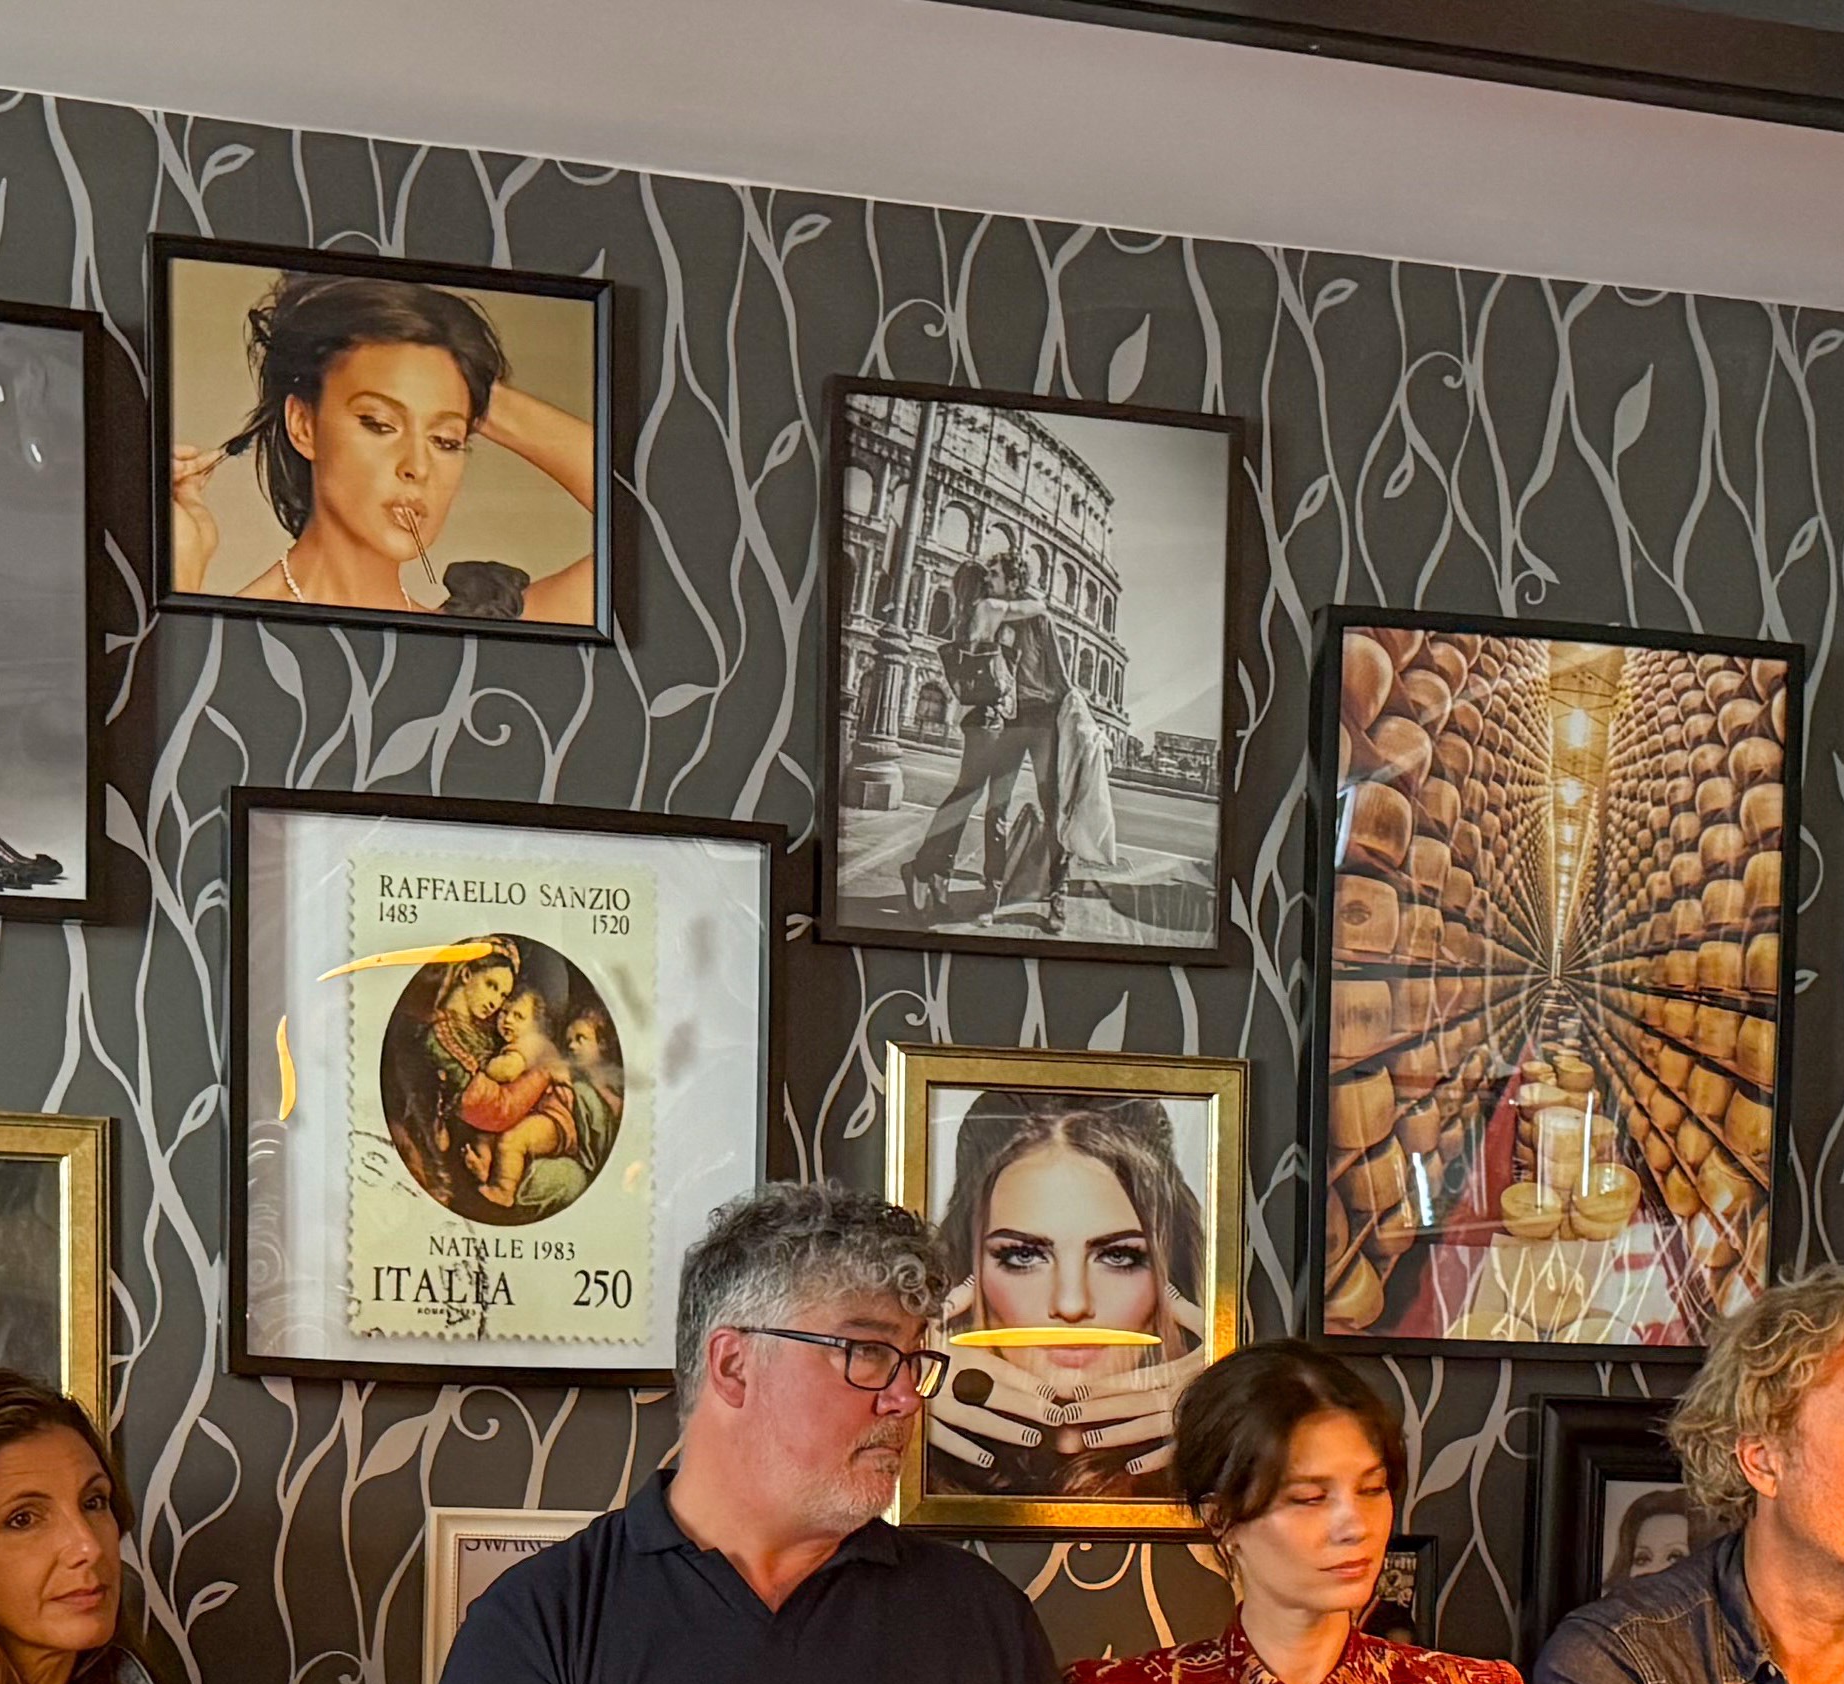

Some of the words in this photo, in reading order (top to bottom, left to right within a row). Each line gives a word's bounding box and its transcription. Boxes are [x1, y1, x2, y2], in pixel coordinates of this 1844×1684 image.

[379, 874, 526, 906] RAFFAELLO
[540, 884, 631, 913] SANZIO
[379, 902, 419, 924] 1483
[592, 914, 630, 936] 1520
[429, 1235, 523, 1260] NATALE
[534, 1241, 576, 1261] 1983
[372, 1266, 516, 1307] ITALIA
[572, 1269, 632, 1309] 250
